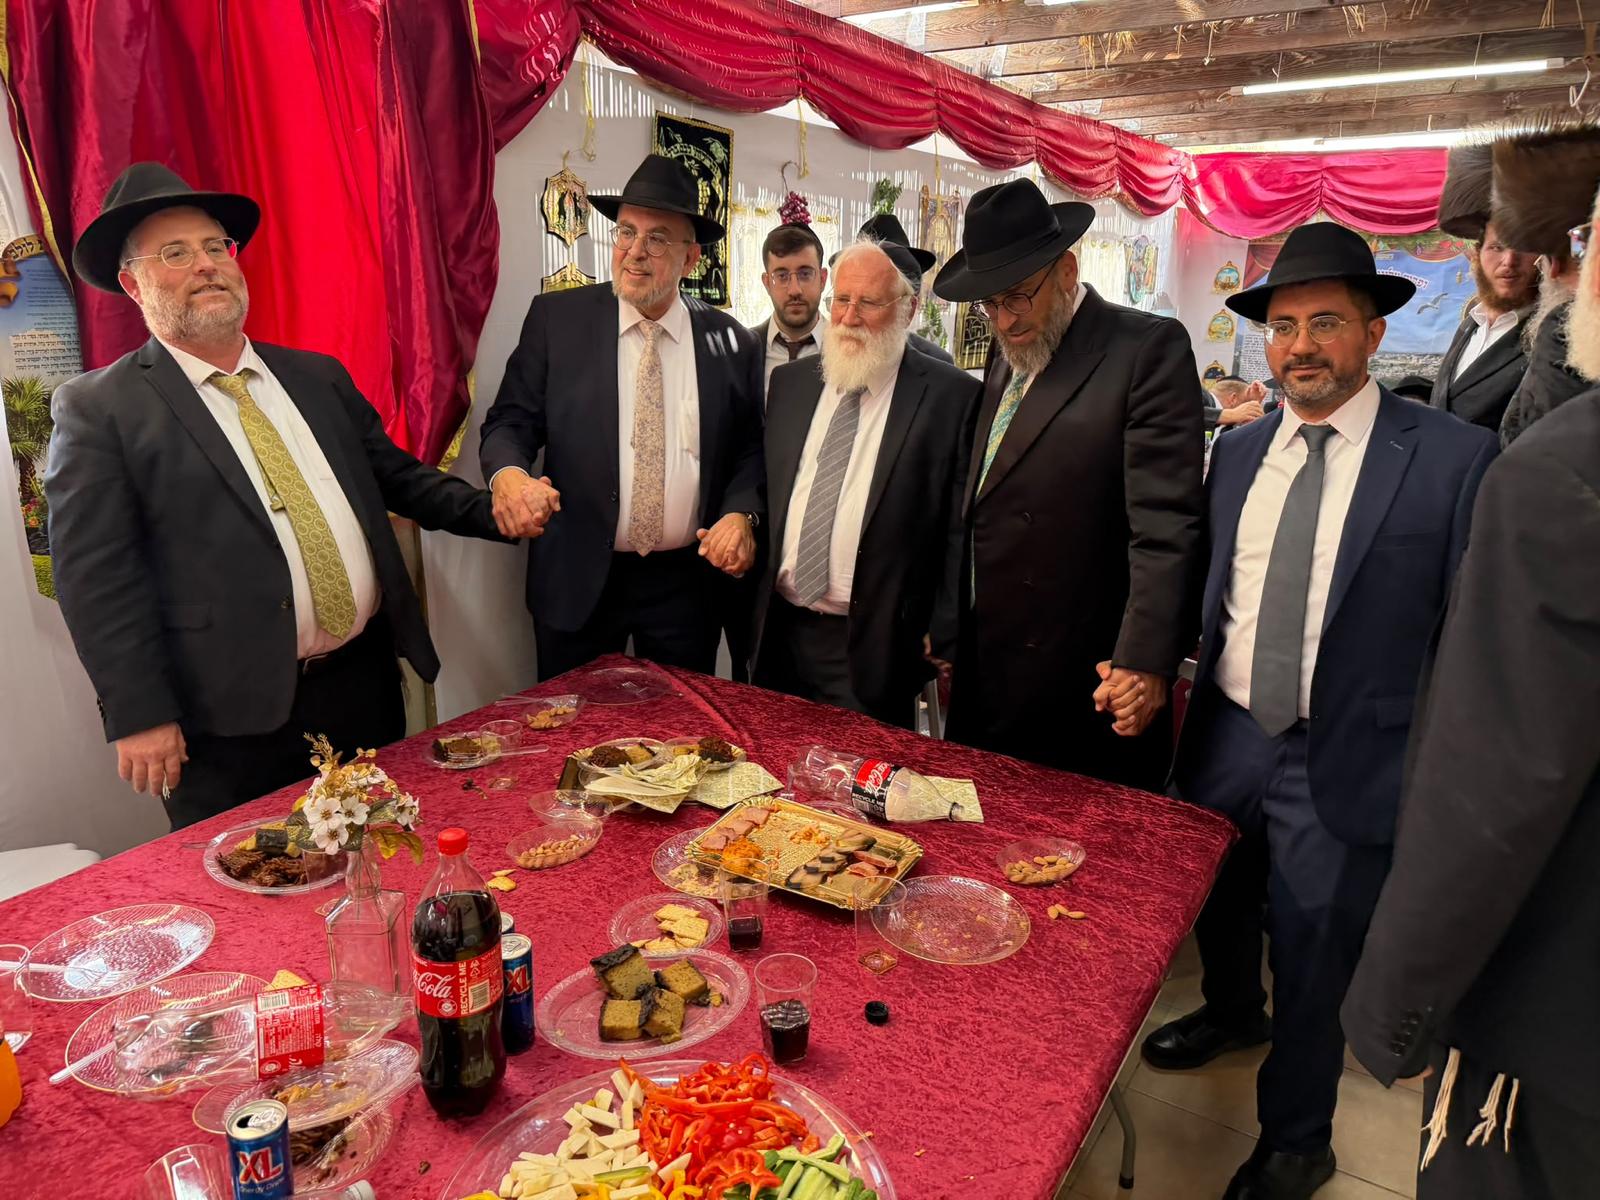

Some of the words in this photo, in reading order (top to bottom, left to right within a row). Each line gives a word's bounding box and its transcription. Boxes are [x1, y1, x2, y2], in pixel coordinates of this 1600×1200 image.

[458, 961, 467, 976] ME
[504, 964, 531, 994] XL
[459, 977, 469, 1015] RECYCLE
[238, 1147, 283, 1184] XL
